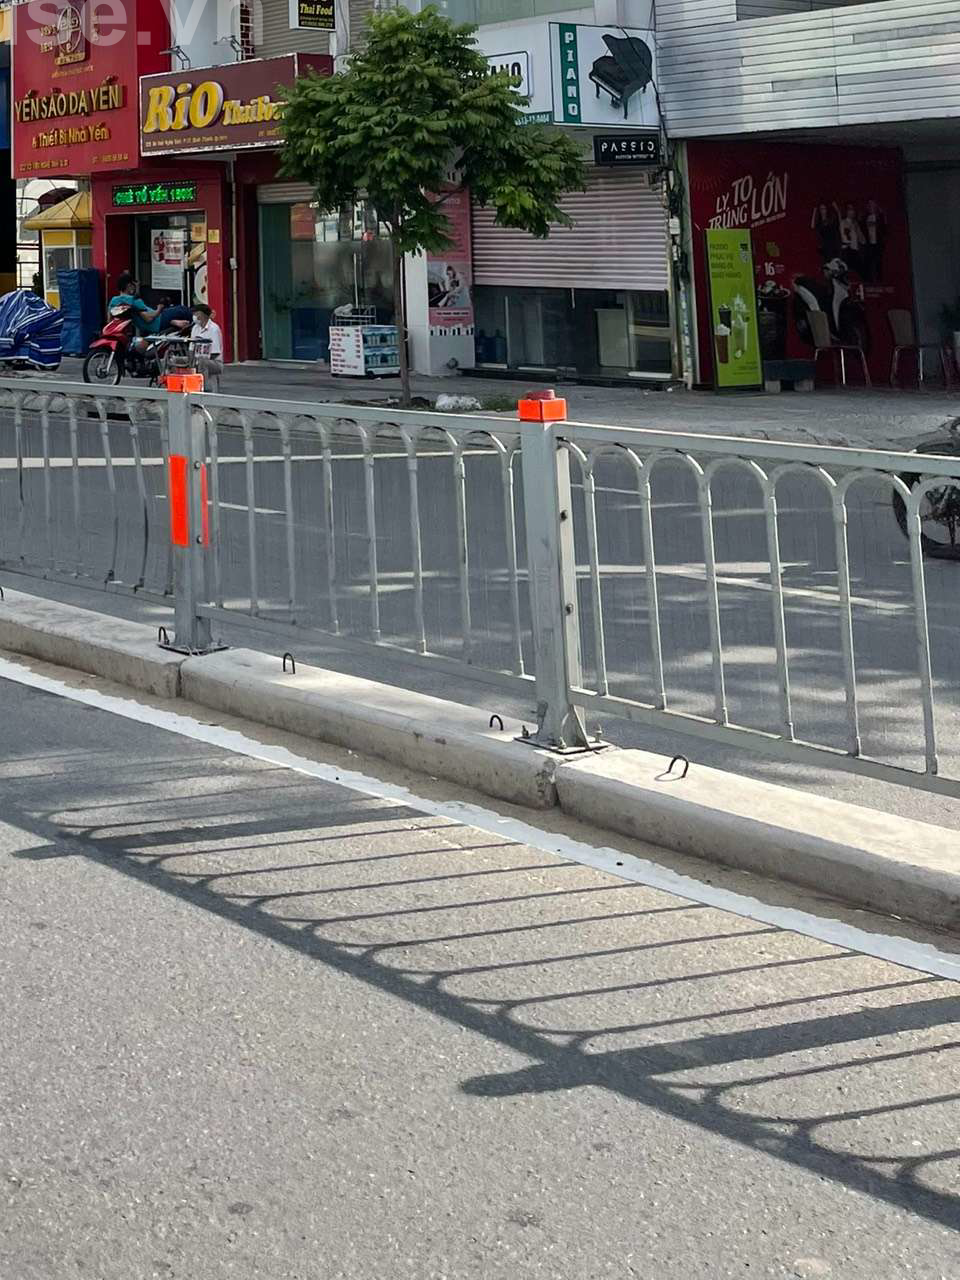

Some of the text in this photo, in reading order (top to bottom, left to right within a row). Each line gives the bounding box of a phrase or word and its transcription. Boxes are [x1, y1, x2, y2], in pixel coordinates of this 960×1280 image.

[300, 3, 333, 16] Thai Food
[564, 31, 579, 117] PIANO
[14, 88, 39, 122] YẾN
[69, 90, 88, 116] DẠ
[90, 75, 121, 112] YẾN
[88, 122, 108, 141] Yến
[716, 175, 753, 213] LY TO
[751, 171, 788, 220] LỚN
